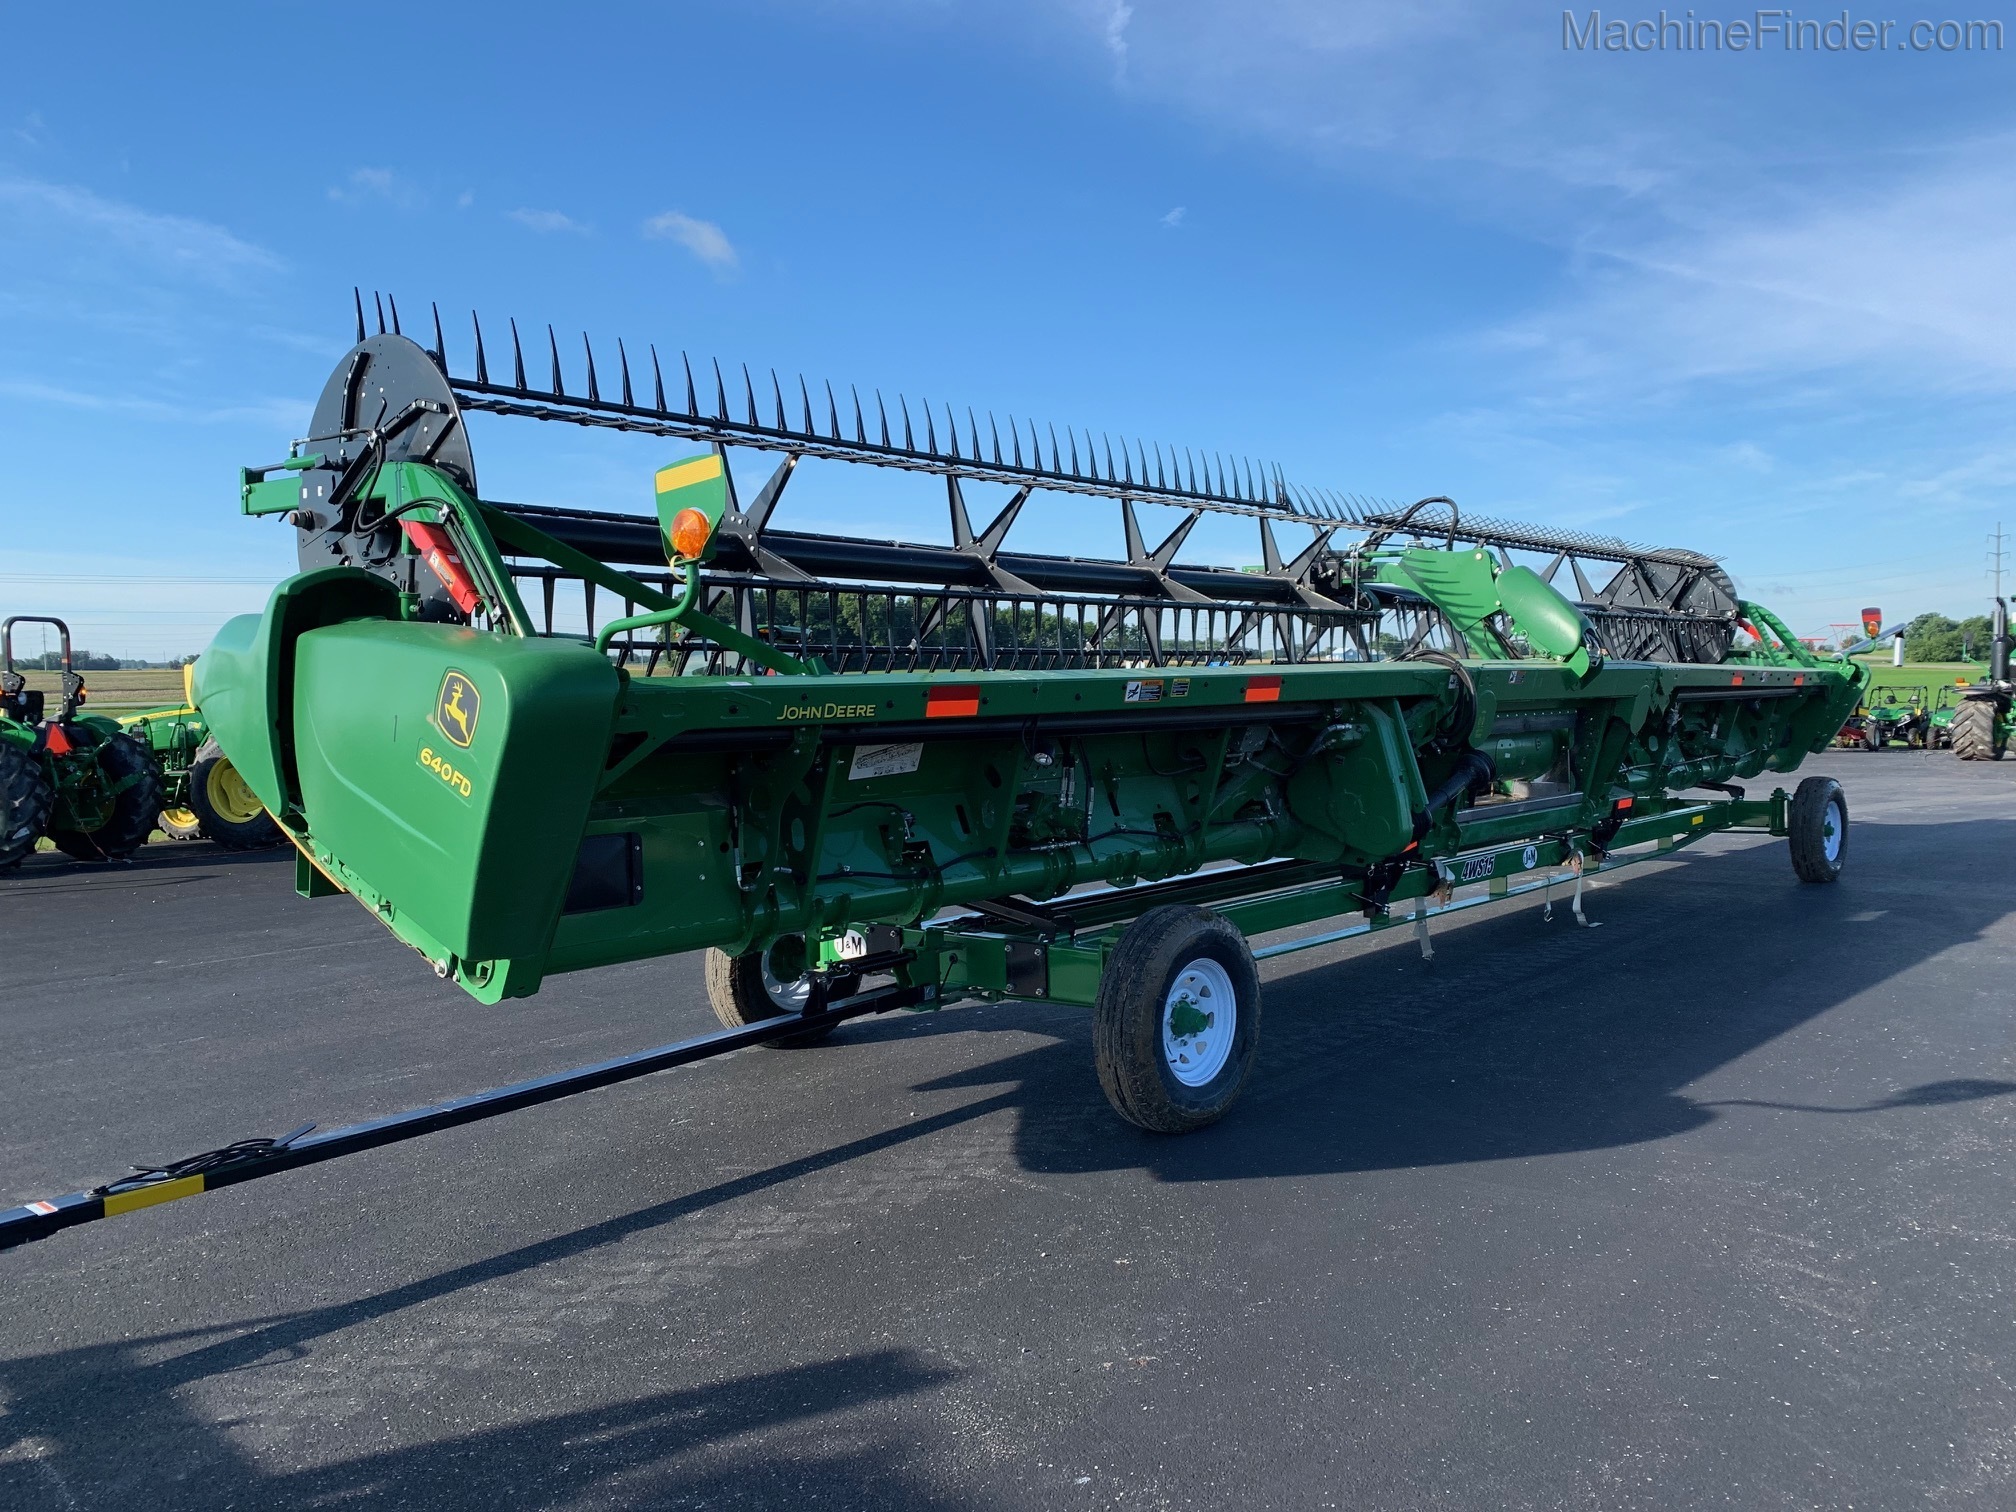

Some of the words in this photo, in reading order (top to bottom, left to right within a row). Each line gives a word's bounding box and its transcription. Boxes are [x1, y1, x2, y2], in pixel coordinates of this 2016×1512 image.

[776, 705, 822, 720] JOHN
[824, 703, 876, 718] DEERE
[420, 747, 472, 797] 640FD
[1461, 855, 1496, 881] 4WS15
